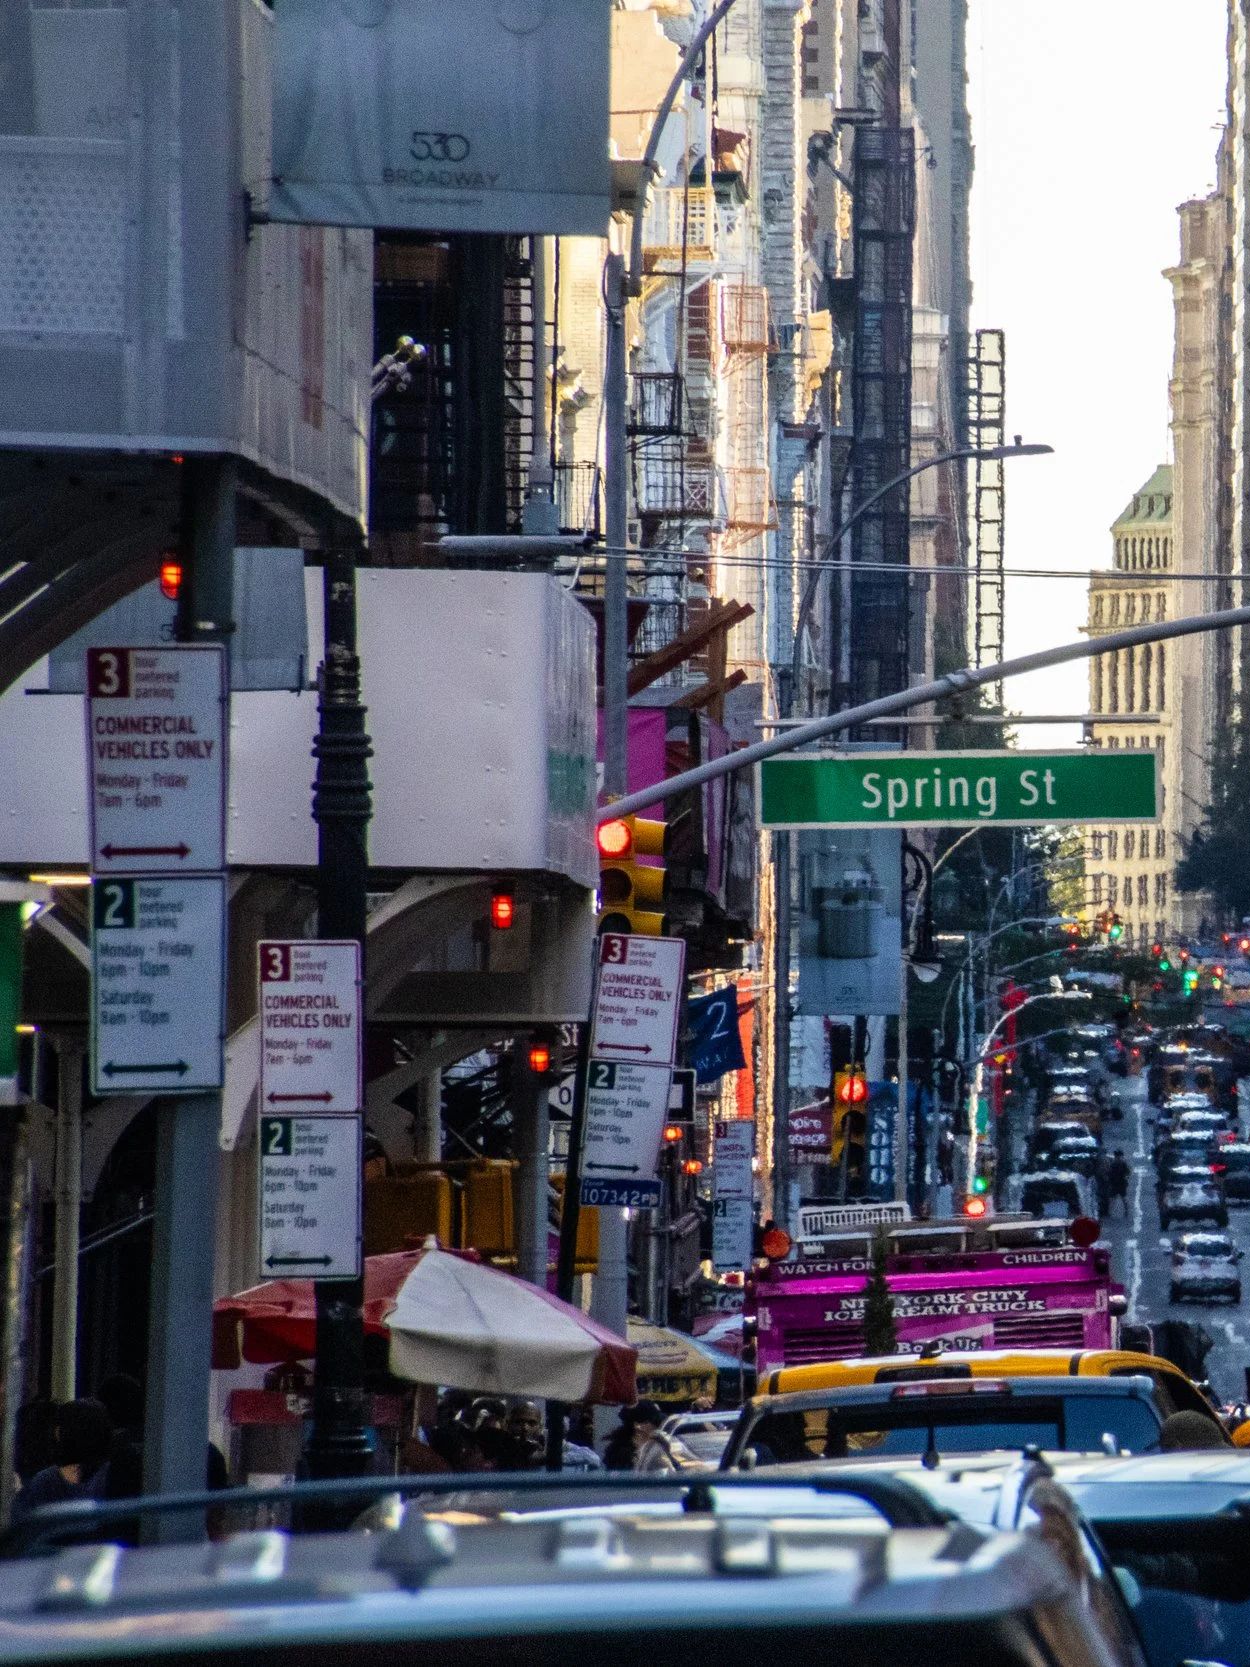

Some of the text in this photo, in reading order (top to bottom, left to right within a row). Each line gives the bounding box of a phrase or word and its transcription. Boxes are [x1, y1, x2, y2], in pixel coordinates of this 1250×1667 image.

[410, 131, 470, 161] 530
[383, 168, 500, 187] BROADWAY
[98, 653, 119, 694] 3
[136, 671, 179, 683] metered
[136, 688, 175, 699] parking
[95, 716, 197, 734] COMMERCIAL
[96, 740, 214, 759] VEHICLES ONLY
[96, 773, 188, 789] Monday Friday
[862, 768, 1056, 818] Spring St
[104, 885, 124, 926] 2
[140, 902, 183, 912] metered
[140, 918, 178, 929] parking
[100, 941, 194, 958] Monday Friday
[607, 939, 622, 962] 3
[268, 948, 283, 979] 3
[295, 961, 327, 970] metered
[295, 973, 323, 983] parking
[603, 974, 663, 988] COMMERCIAL
[100, 990, 153, 1005] Saturday
[602, 986, 672, 1001] VEHICLES ONLY
[265, 995, 339, 1009] COMMERCIAL
[600, 1003, 658, 1017] Monday Friday
[266, 1014, 352, 1028] VEHICLES ONLY
[707, 1002, 729, 1040] 2
[560, 1024, 579, 1046] St
[265, 1038, 332, 1050] Monday Friday
[595, 1065, 609, 1087] 2
[590, 1096, 649, 1108] Monday Friday
[269, 1122, 283, 1153] 2
[295, 1134, 328, 1144] metered
[295, 1146, 324, 1156] parking
[265, 1165, 336, 1177] Monday Friday
[584, 1187, 640, 1205] 107342
[265, 1202, 304, 1214] Saturday
[778, 1252, 1088, 1275] WATCH FOR CHILDREN
[840, 1290, 1029, 1311] NE YORK CITY
[824, 1300, 1046, 1322] ICE REAM TRUCK
[897, 1340, 951, 1354] Bok
